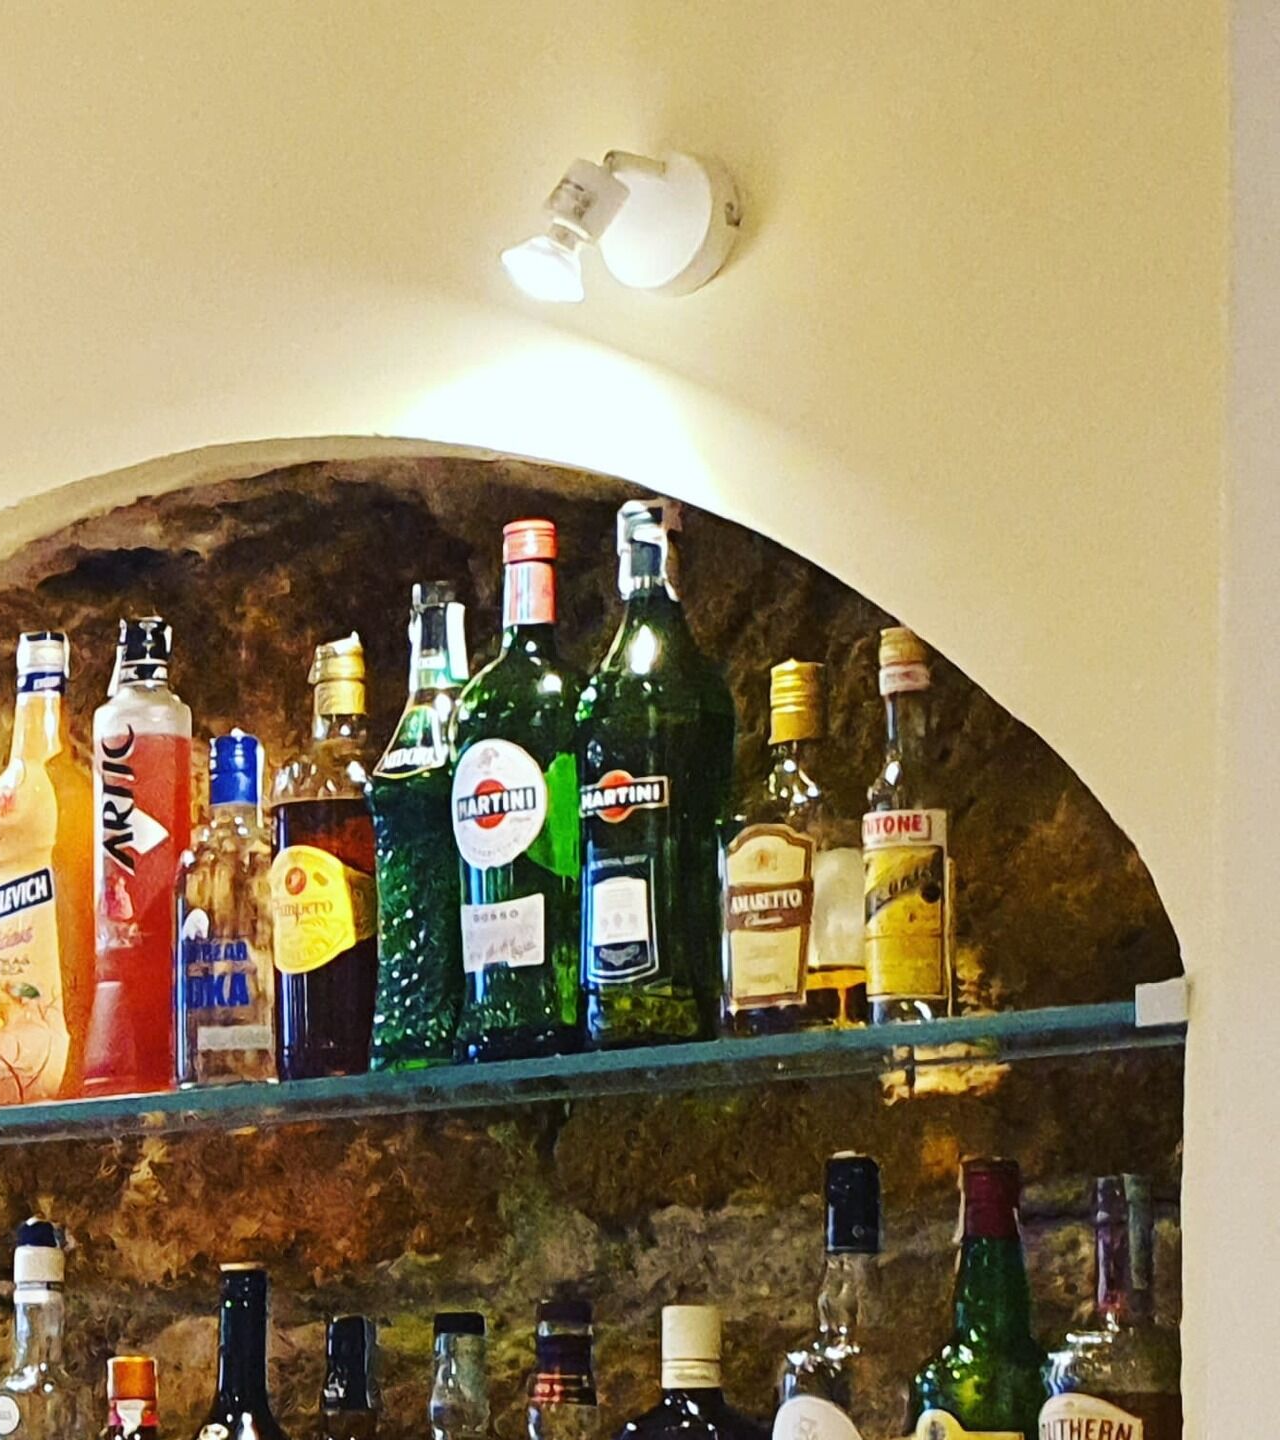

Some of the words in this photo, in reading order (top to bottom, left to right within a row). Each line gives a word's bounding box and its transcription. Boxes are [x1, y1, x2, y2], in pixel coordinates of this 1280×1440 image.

[101, 723, 135, 876] ARTIC
[458, 783, 534, 820] MARTINI
[581, 783, 660, 810] MARTINI
[731, 888, 802, 913] AMARETTO
